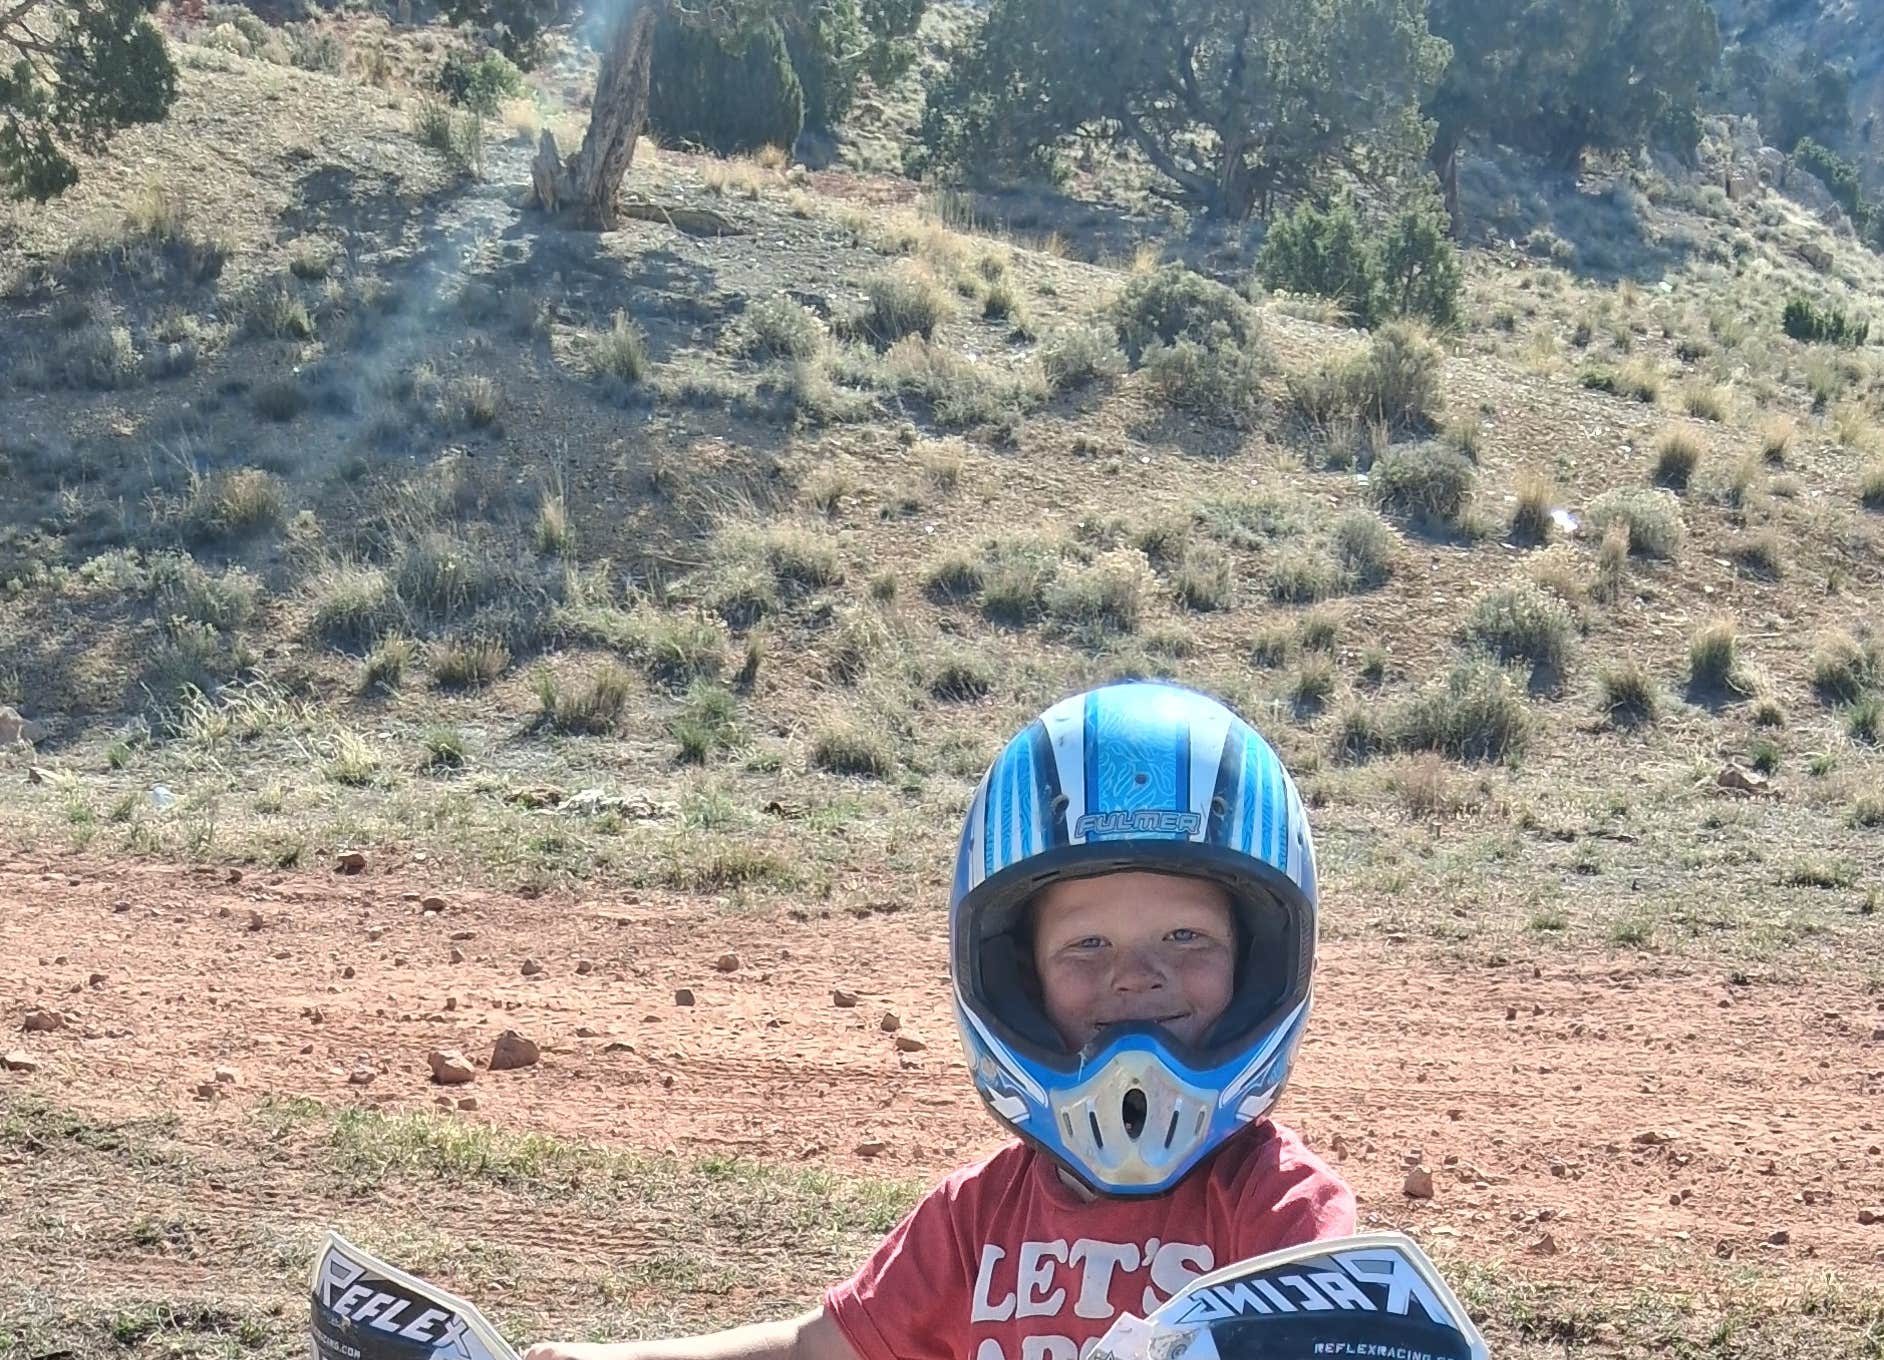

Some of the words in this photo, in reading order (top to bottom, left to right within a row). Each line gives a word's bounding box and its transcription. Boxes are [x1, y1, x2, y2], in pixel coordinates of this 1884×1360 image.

[1074, 810, 1200, 838] FULMER
[316, 1249, 472, 1360] REFLEX
[970, 1237, 1215, 1325] LET'S
